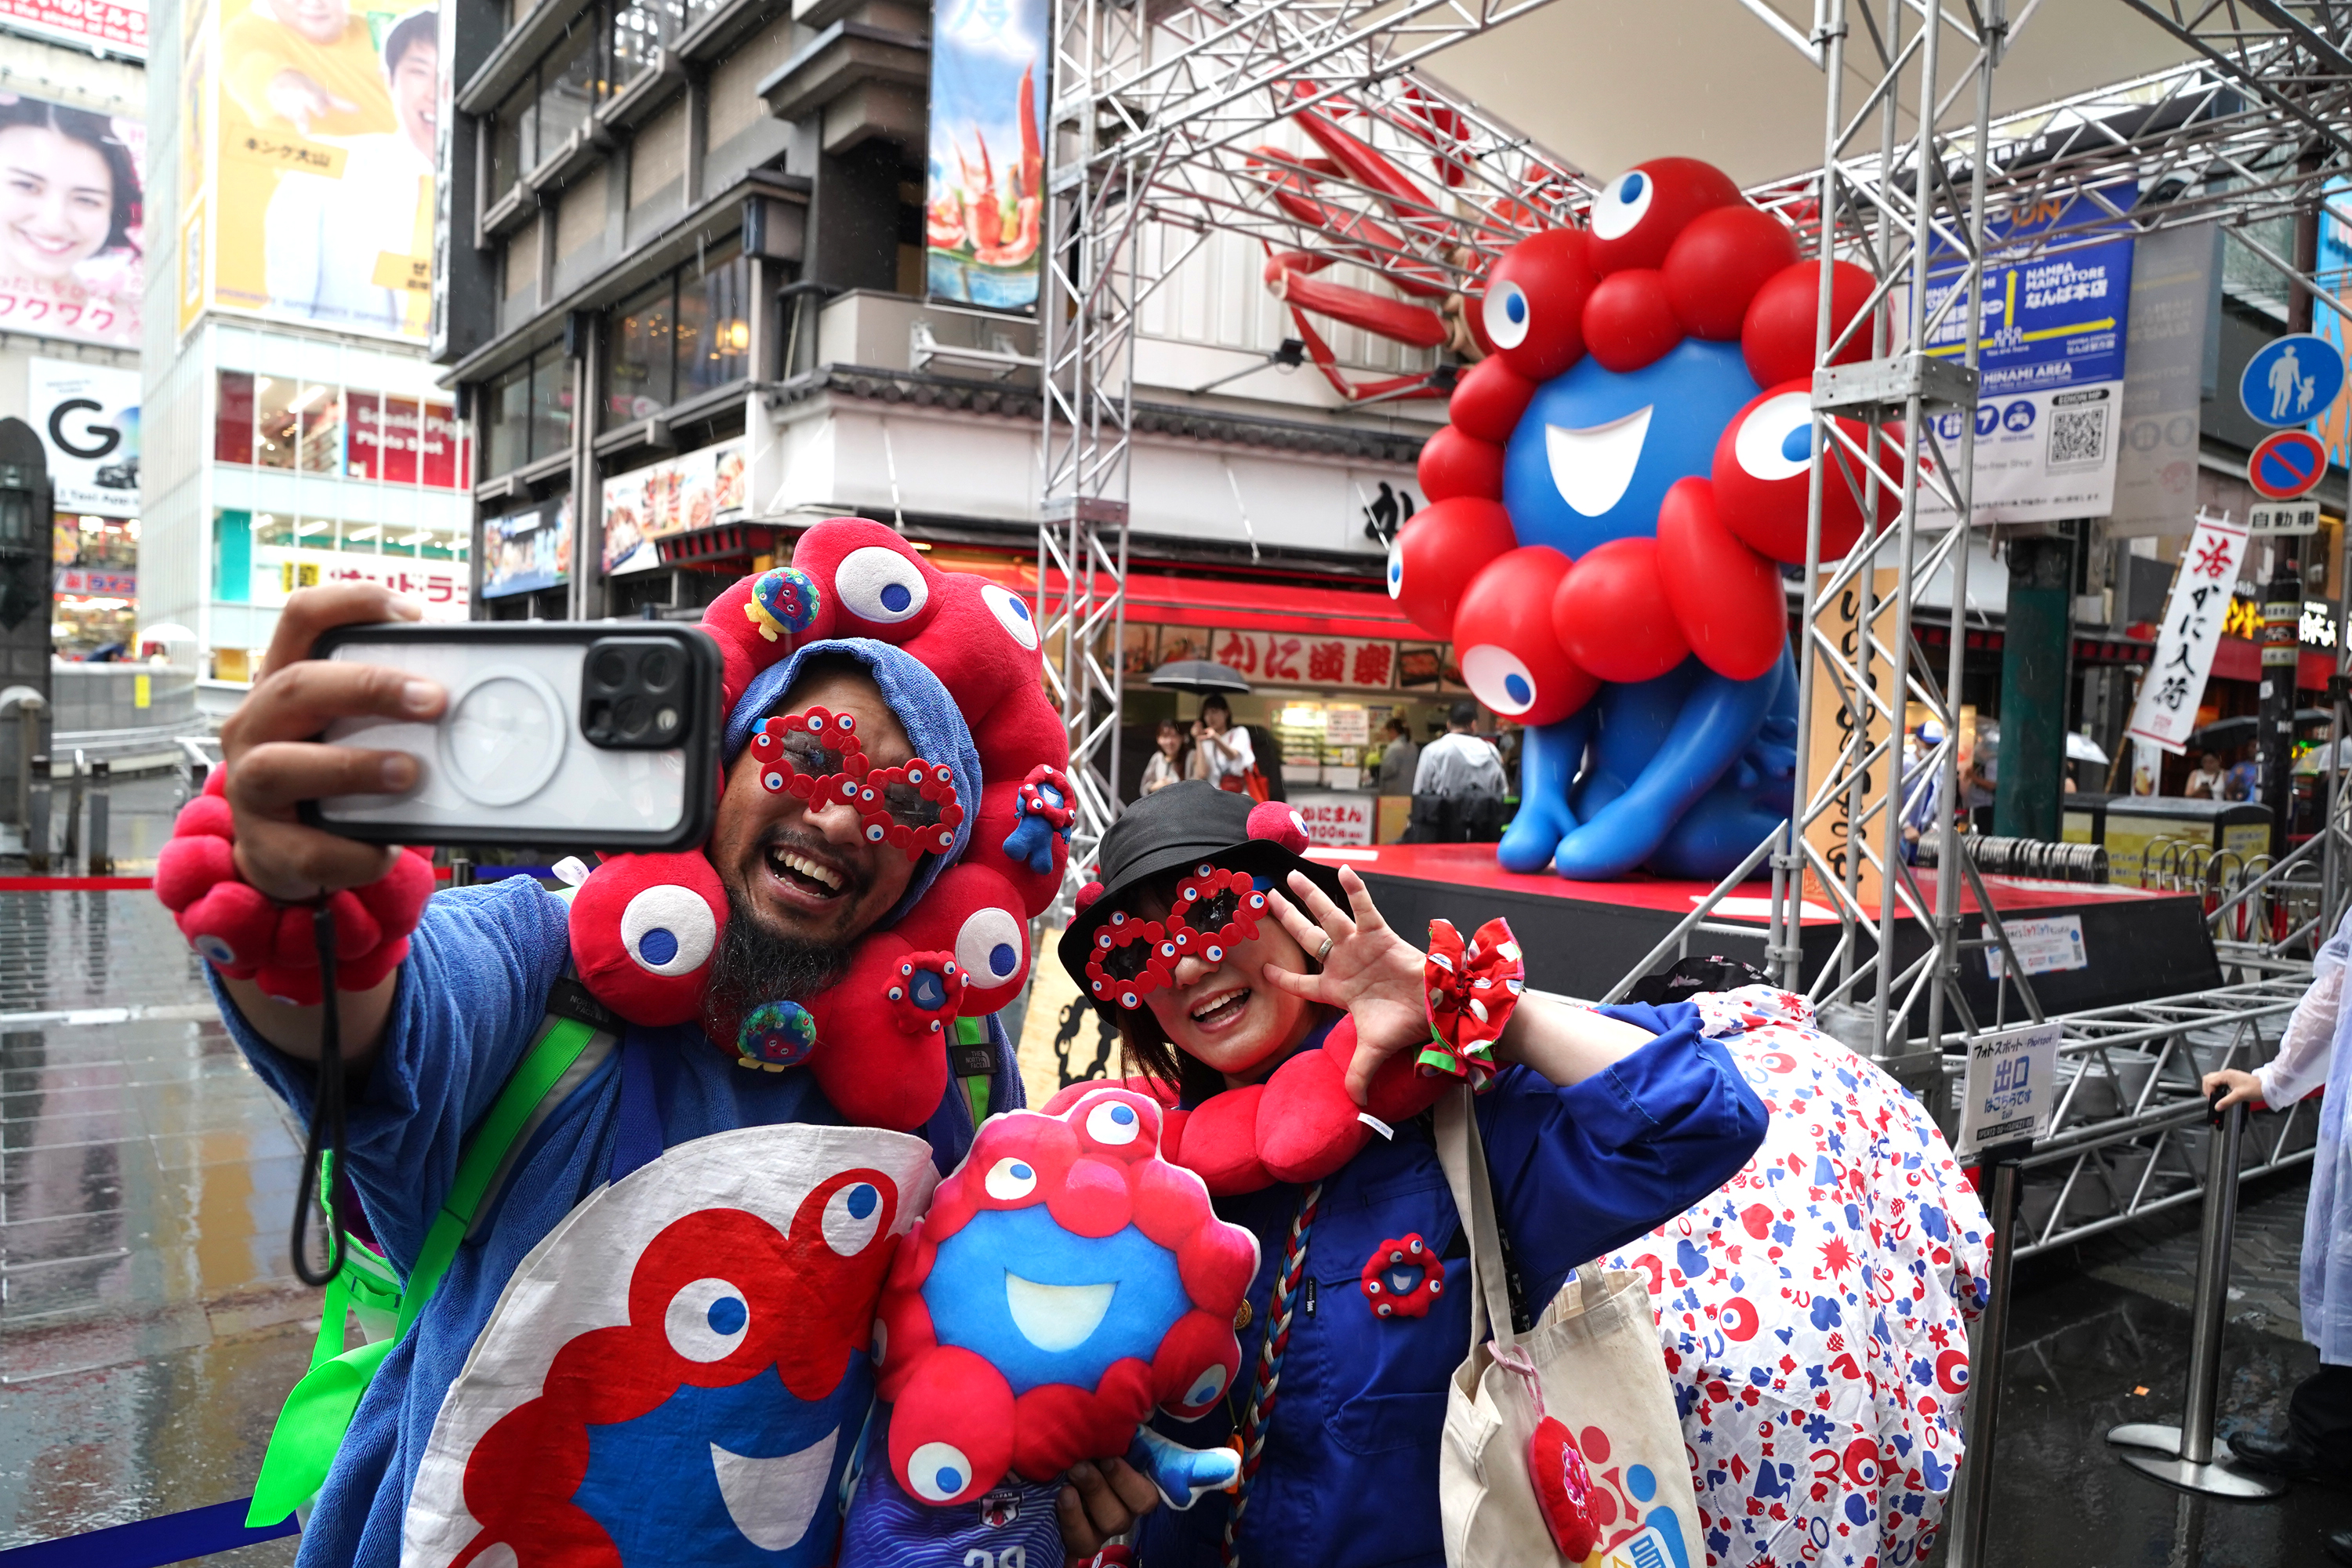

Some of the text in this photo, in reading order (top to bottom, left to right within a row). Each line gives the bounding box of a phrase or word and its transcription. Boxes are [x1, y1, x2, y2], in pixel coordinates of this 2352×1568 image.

[2025, 266, 2106, 292] MAIN STORE
[2027, 261, 2074, 279] NAMBA
[2024, 278, 2108, 309] なんば本店
[1984, 367, 2034, 386] MINAMI
[2035, 361, 2072, 377] AREA
[356, 430, 405, 451] Photo
[2252, 510, 2315, 529] 自動車
[2153, 533, 2234, 713] 活かに入荷
[1974, 1037, 2023, 1059] フォトスポット
[1992, 1055, 2030, 1094] 出口
[1984, 1088, 2032, 1113] はこちらです
